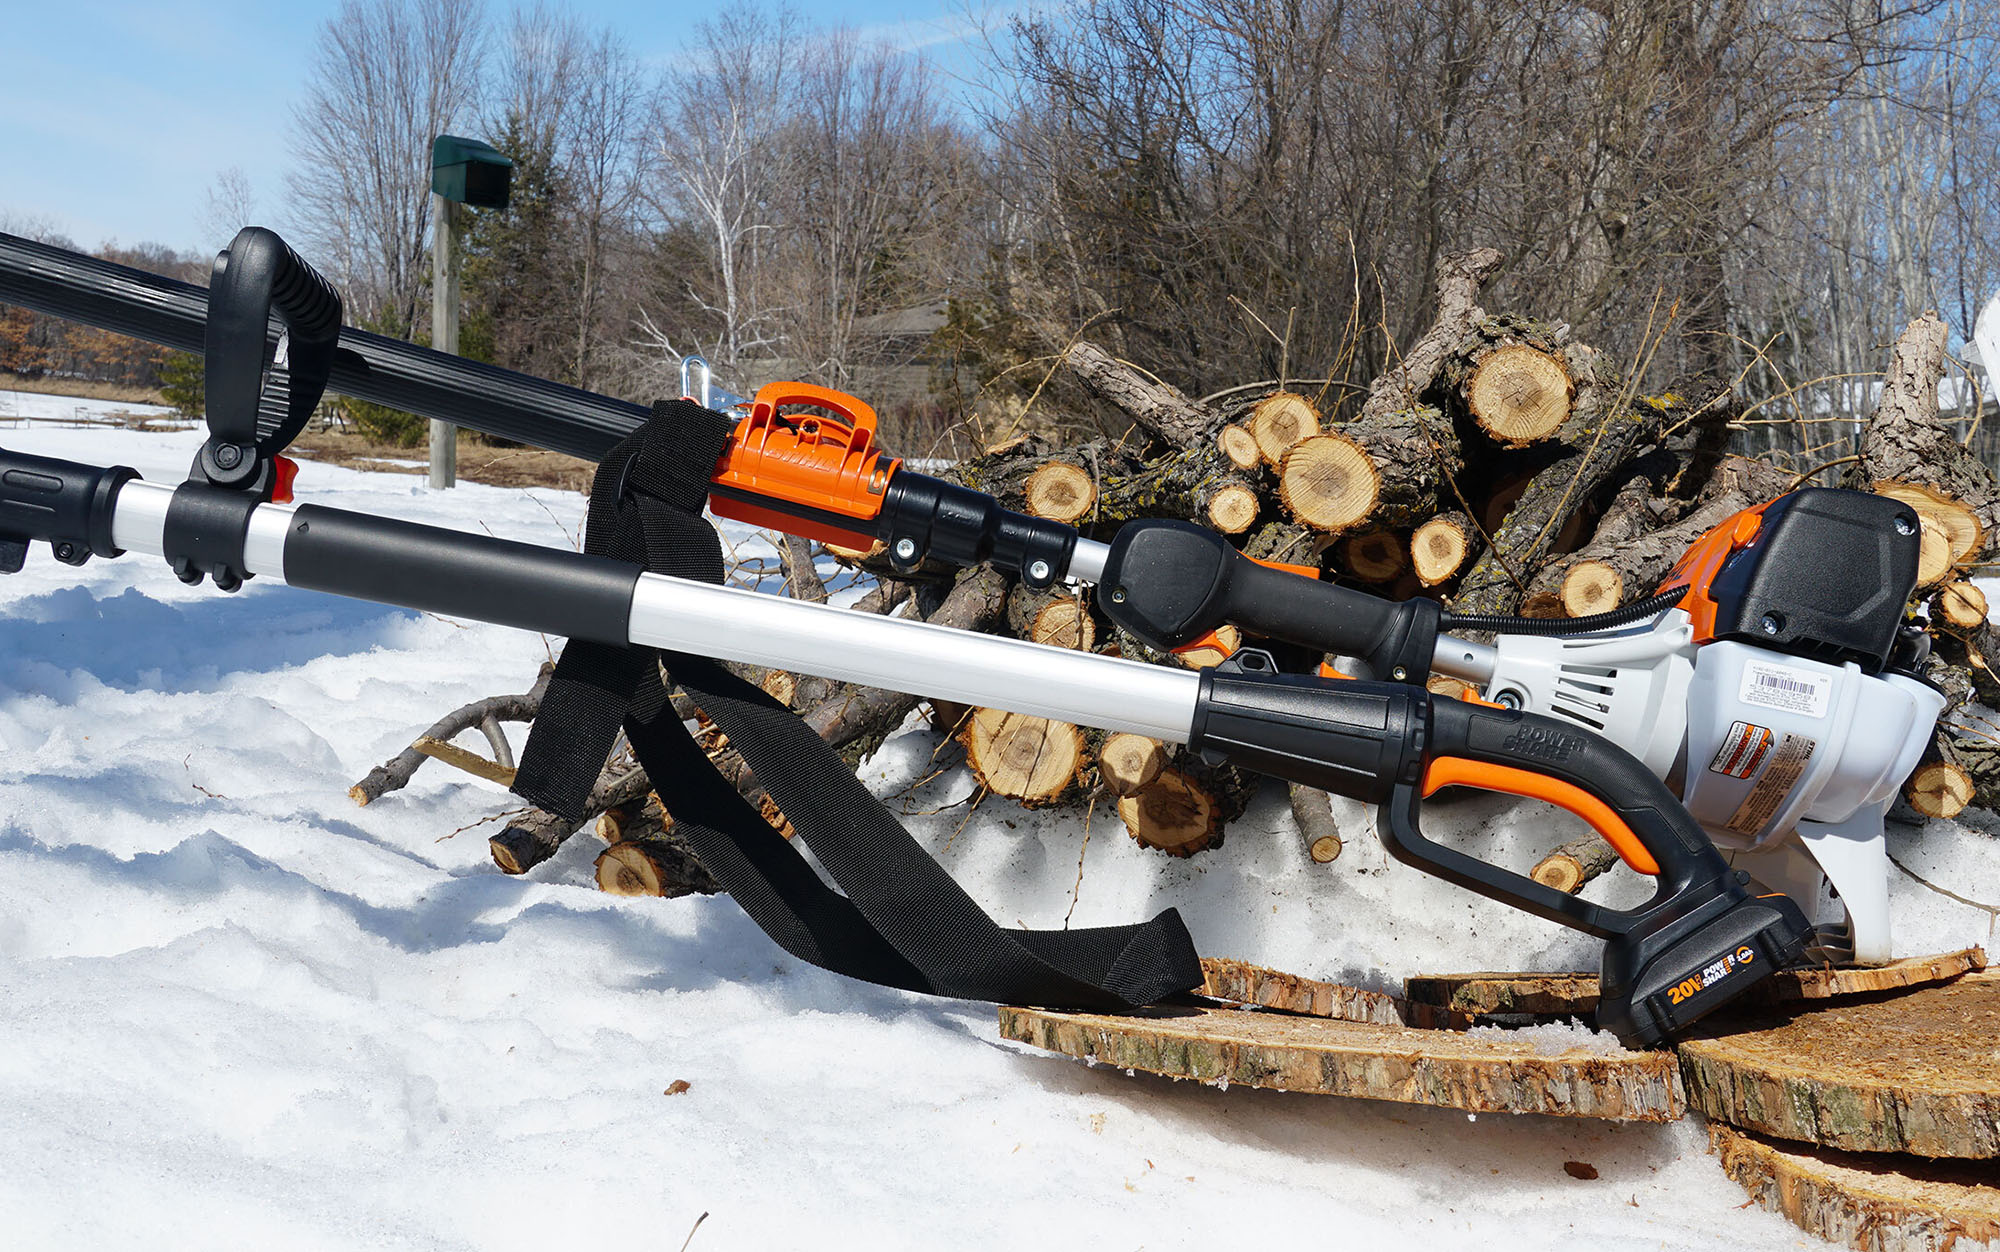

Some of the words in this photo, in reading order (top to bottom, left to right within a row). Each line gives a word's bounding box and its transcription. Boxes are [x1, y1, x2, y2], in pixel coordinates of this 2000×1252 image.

[1503, 735, 1571, 761] SHARE
[1518, 725, 1589, 754] POWER
[1803, 741, 1816, 761] STIHL
[1703, 954, 1735, 977] POWER
[1703, 964, 1732, 987] SHARE
